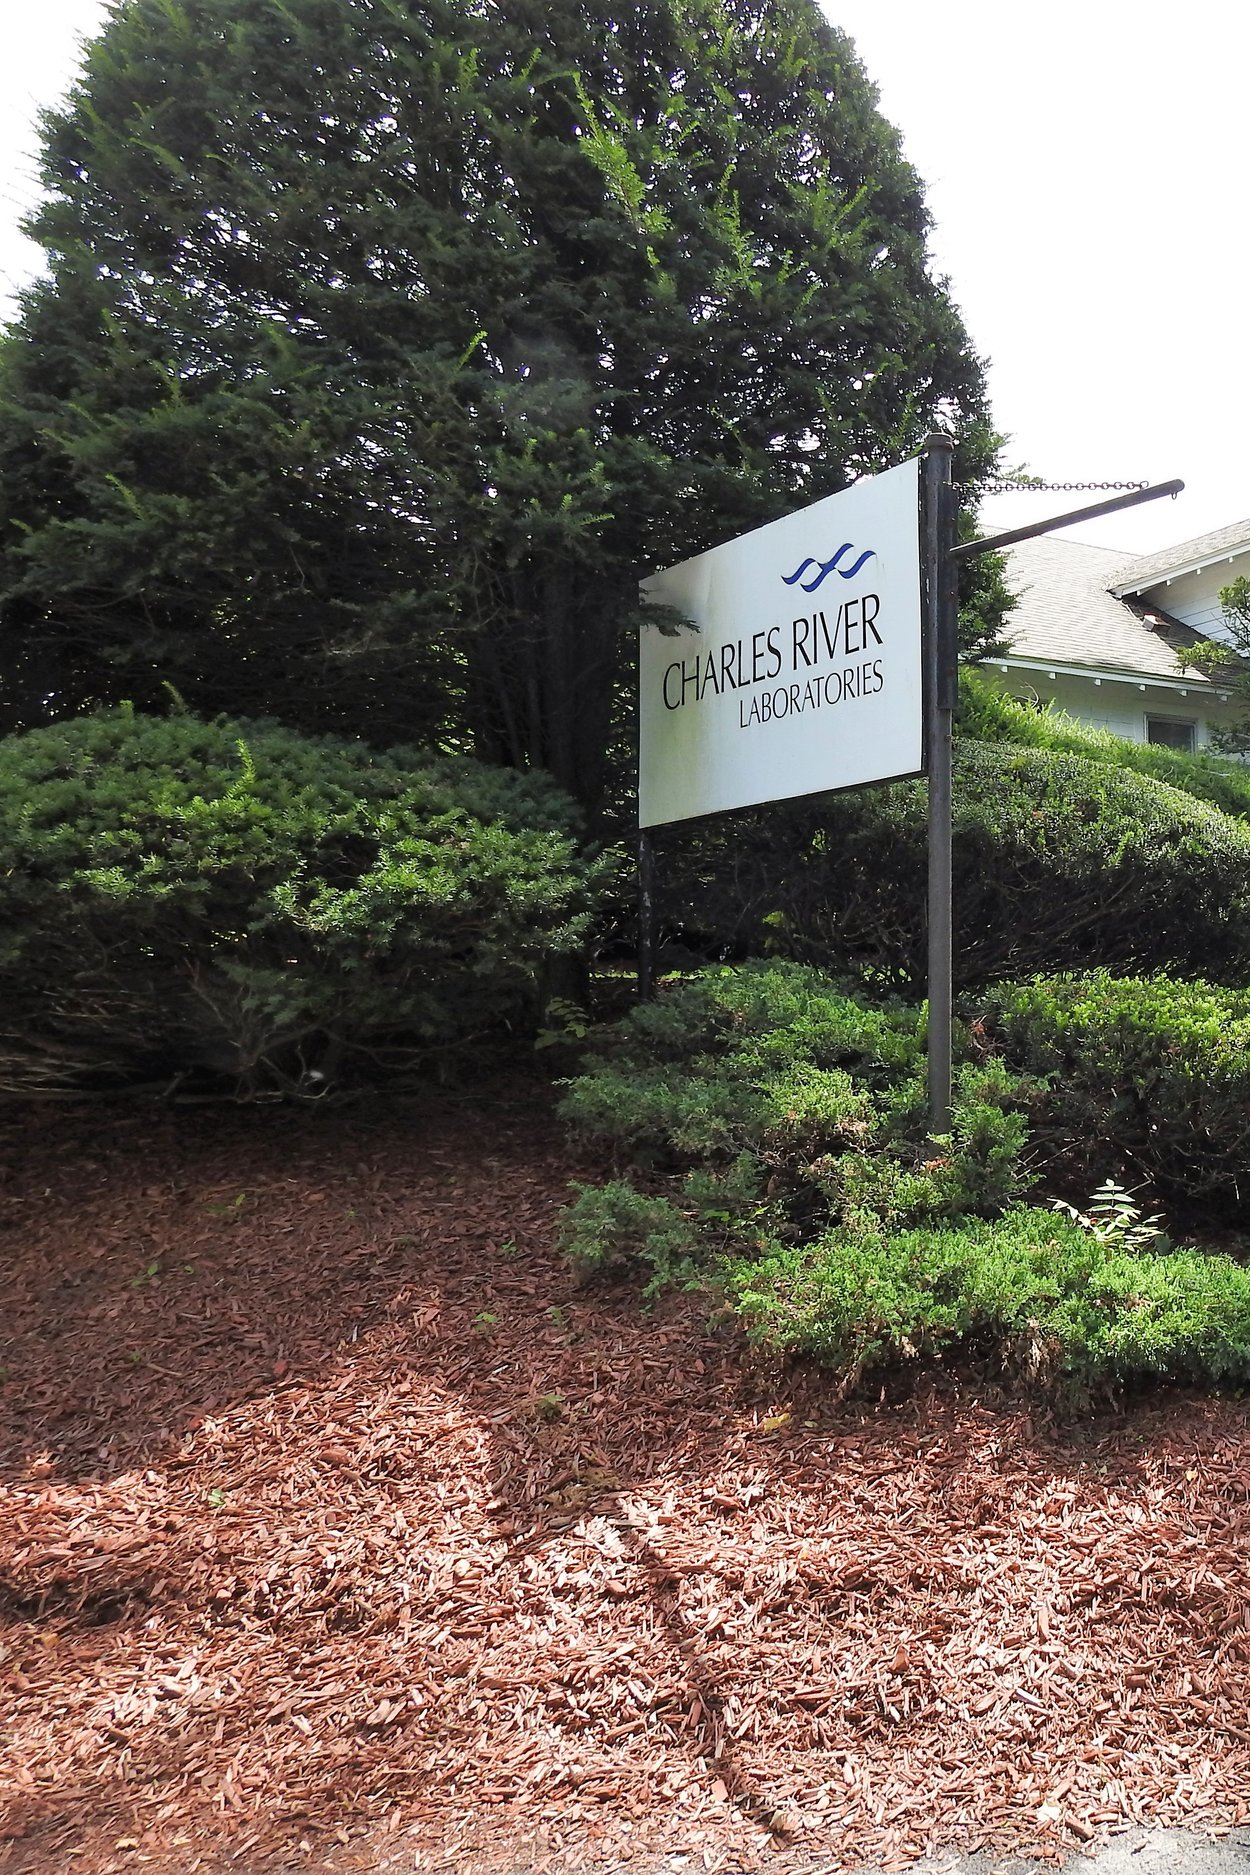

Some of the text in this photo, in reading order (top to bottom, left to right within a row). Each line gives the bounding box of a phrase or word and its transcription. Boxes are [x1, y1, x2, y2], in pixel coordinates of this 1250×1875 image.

[663, 593, 884, 710] CHARLES RIVER
[739, 659, 884, 728] LABORATORIES
